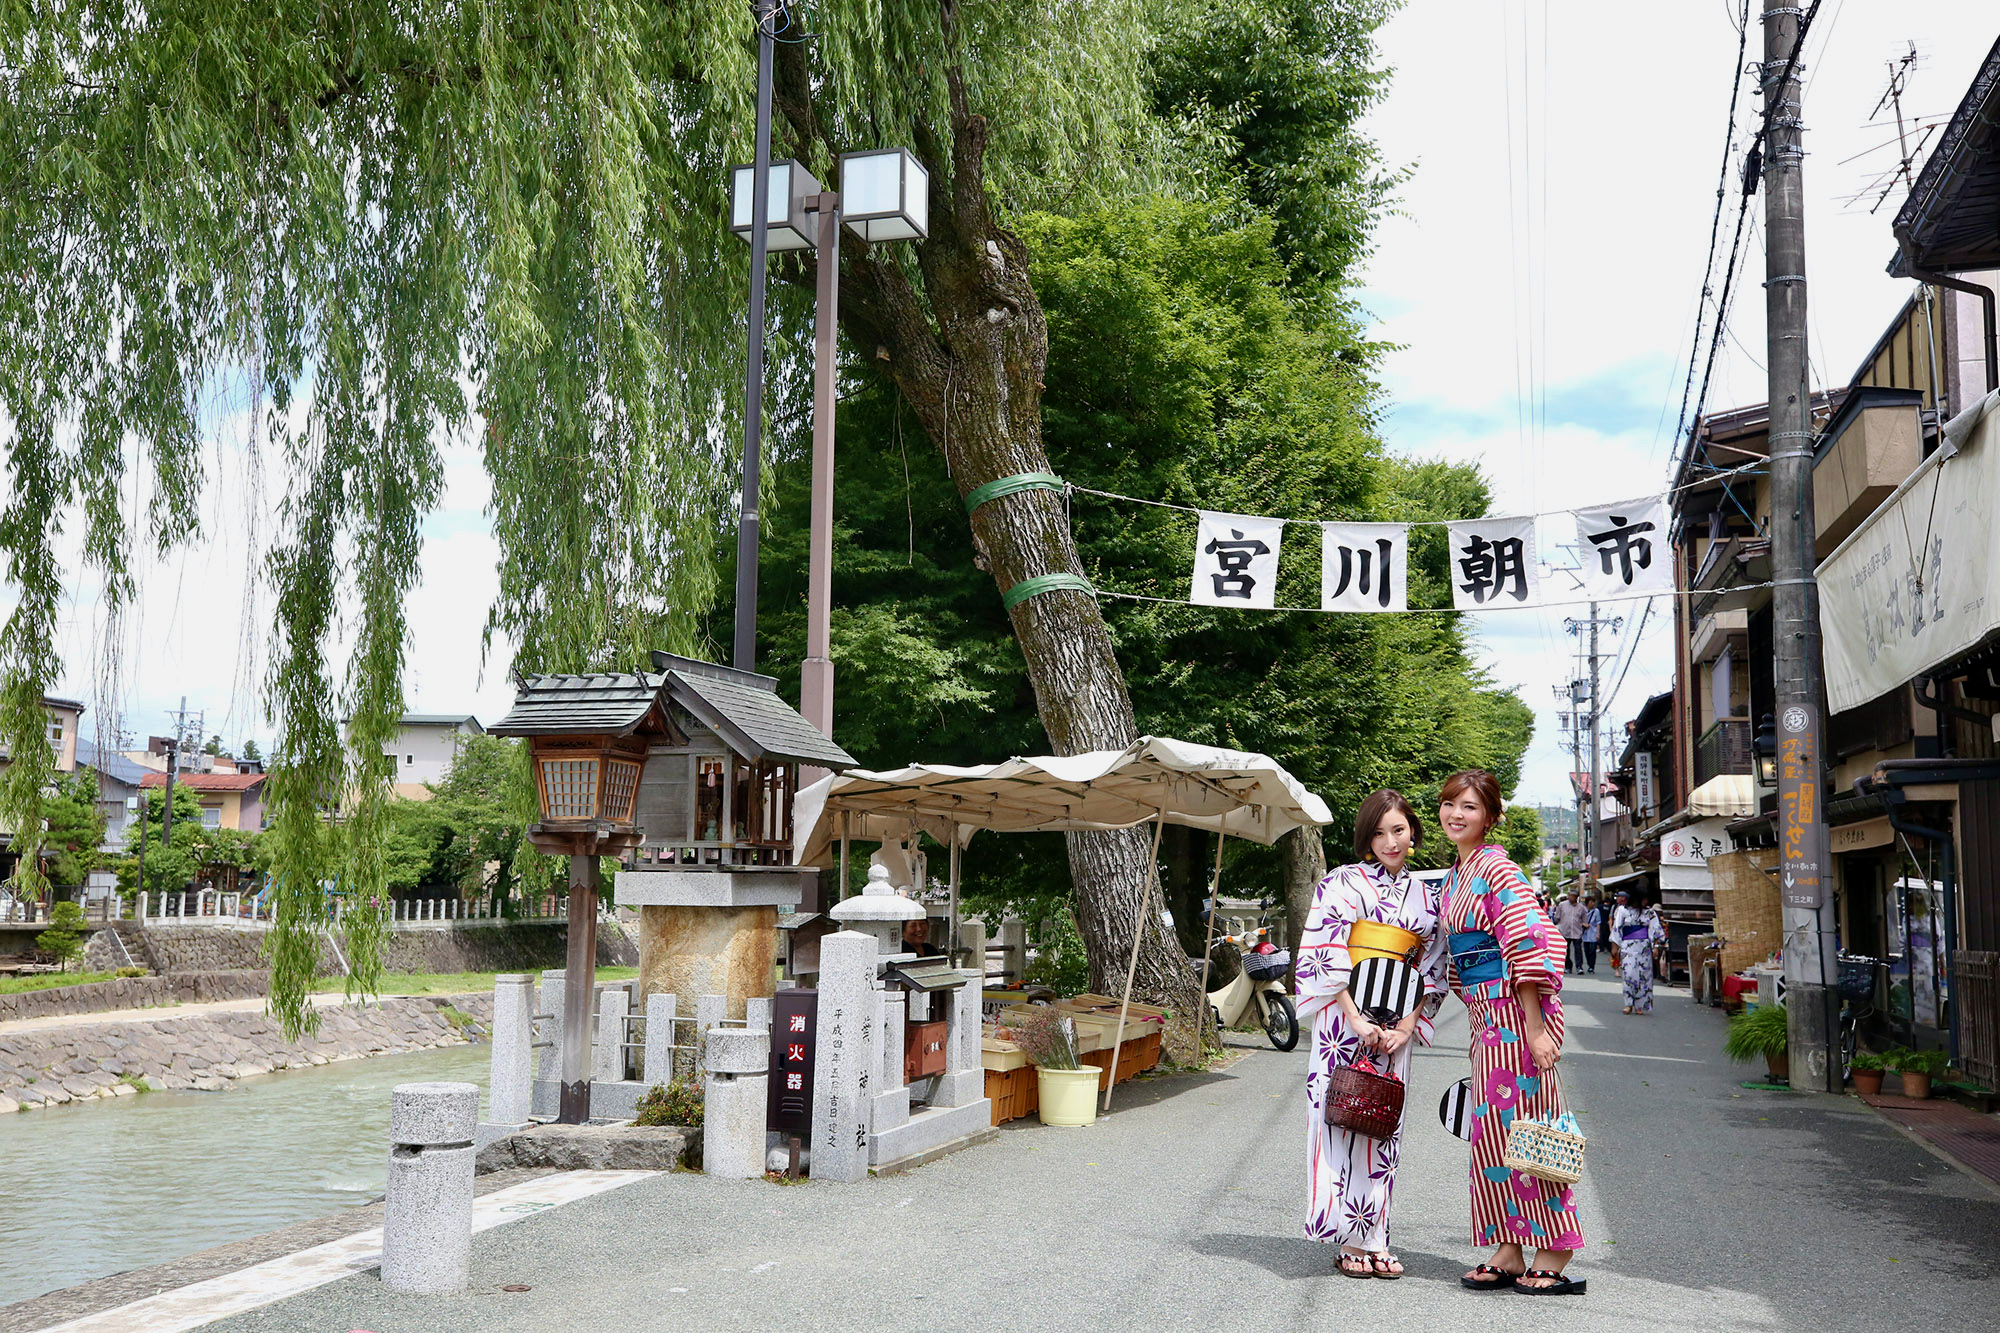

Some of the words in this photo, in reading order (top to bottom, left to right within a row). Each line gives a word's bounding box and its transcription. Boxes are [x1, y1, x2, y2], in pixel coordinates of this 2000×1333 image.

[1205, 515, 1656, 608] 宮川朝市
[1690, 836, 1722, 860] 泉屋
[1788, 896, 1814, 904] 下三之町
[786, 1014, 806, 1091] 消火器
